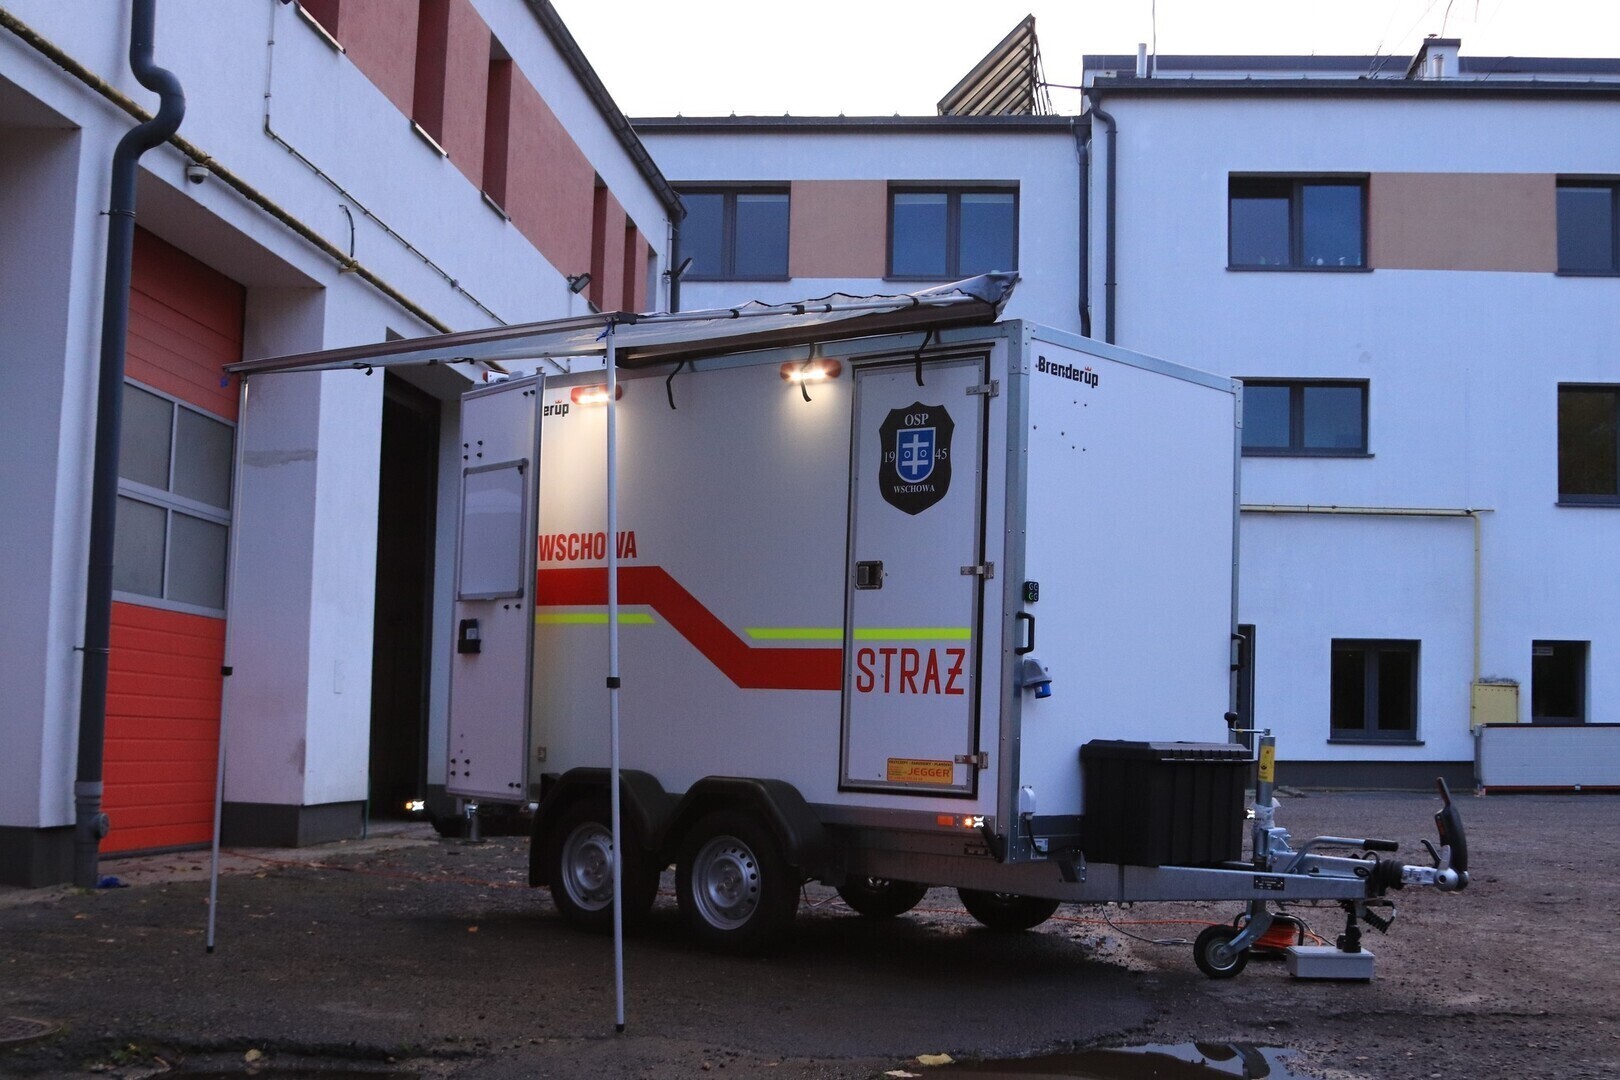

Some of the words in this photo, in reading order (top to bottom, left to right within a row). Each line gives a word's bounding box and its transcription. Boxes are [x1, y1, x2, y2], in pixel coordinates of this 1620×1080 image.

[1038, 355, 1099, 388] Brenderup
[904, 413, 929, 426] OSP
[884, 451, 896, 463] 19
[935, 448, 948, 460] 45
[893, 484, 935, 494] WSCHOWA
[907, 767, 950, 778] JEGGER
